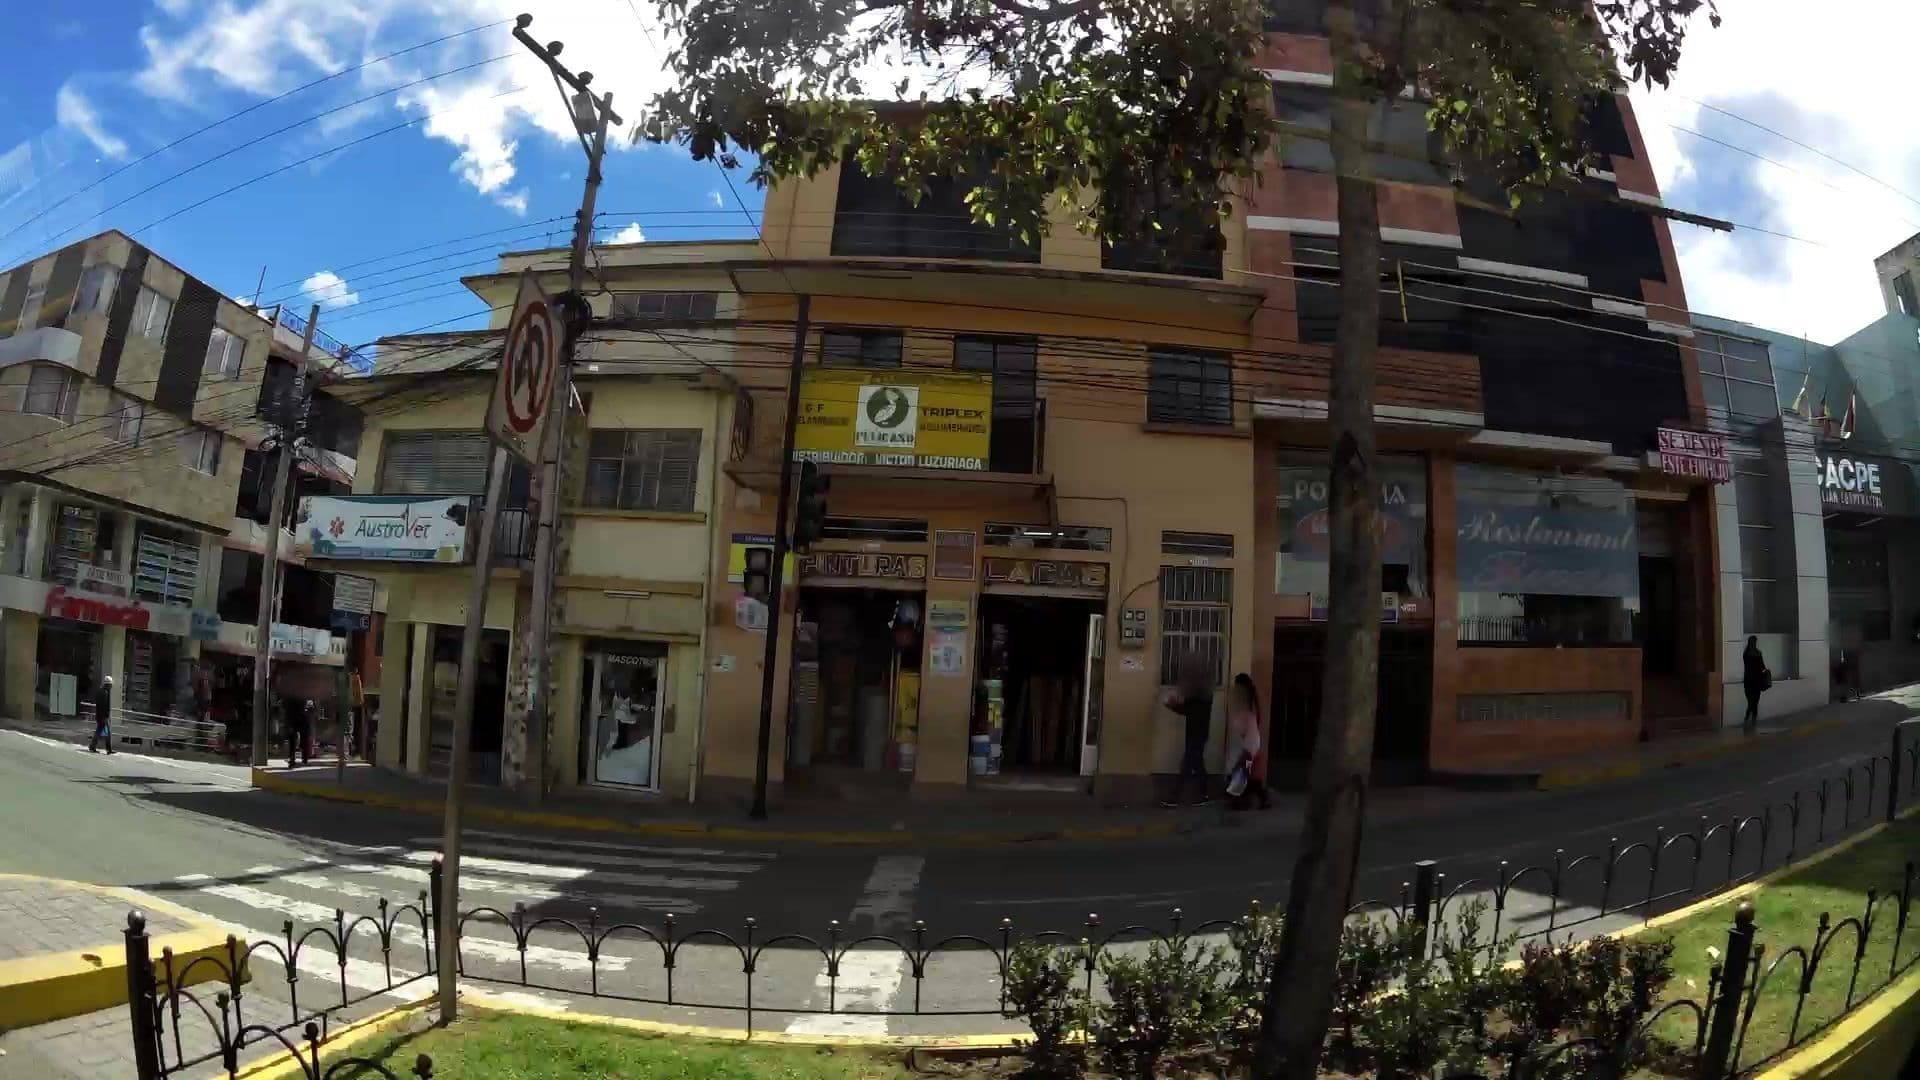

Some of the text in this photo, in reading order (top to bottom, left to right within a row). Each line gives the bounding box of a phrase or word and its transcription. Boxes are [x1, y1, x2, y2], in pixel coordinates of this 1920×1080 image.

[922, 406, 985, 420] TRIPLEX
[875, 453, 916, 466] VICTOR
[918, 455, 982, 470] LUZURIAGA
[1295, 480, 1406, 505] POIA
[355, 510, 433, 539] AustroVet
[799, 552, 926, 579] PINTURAS
[984, 559, 1107, 586] LACAS
